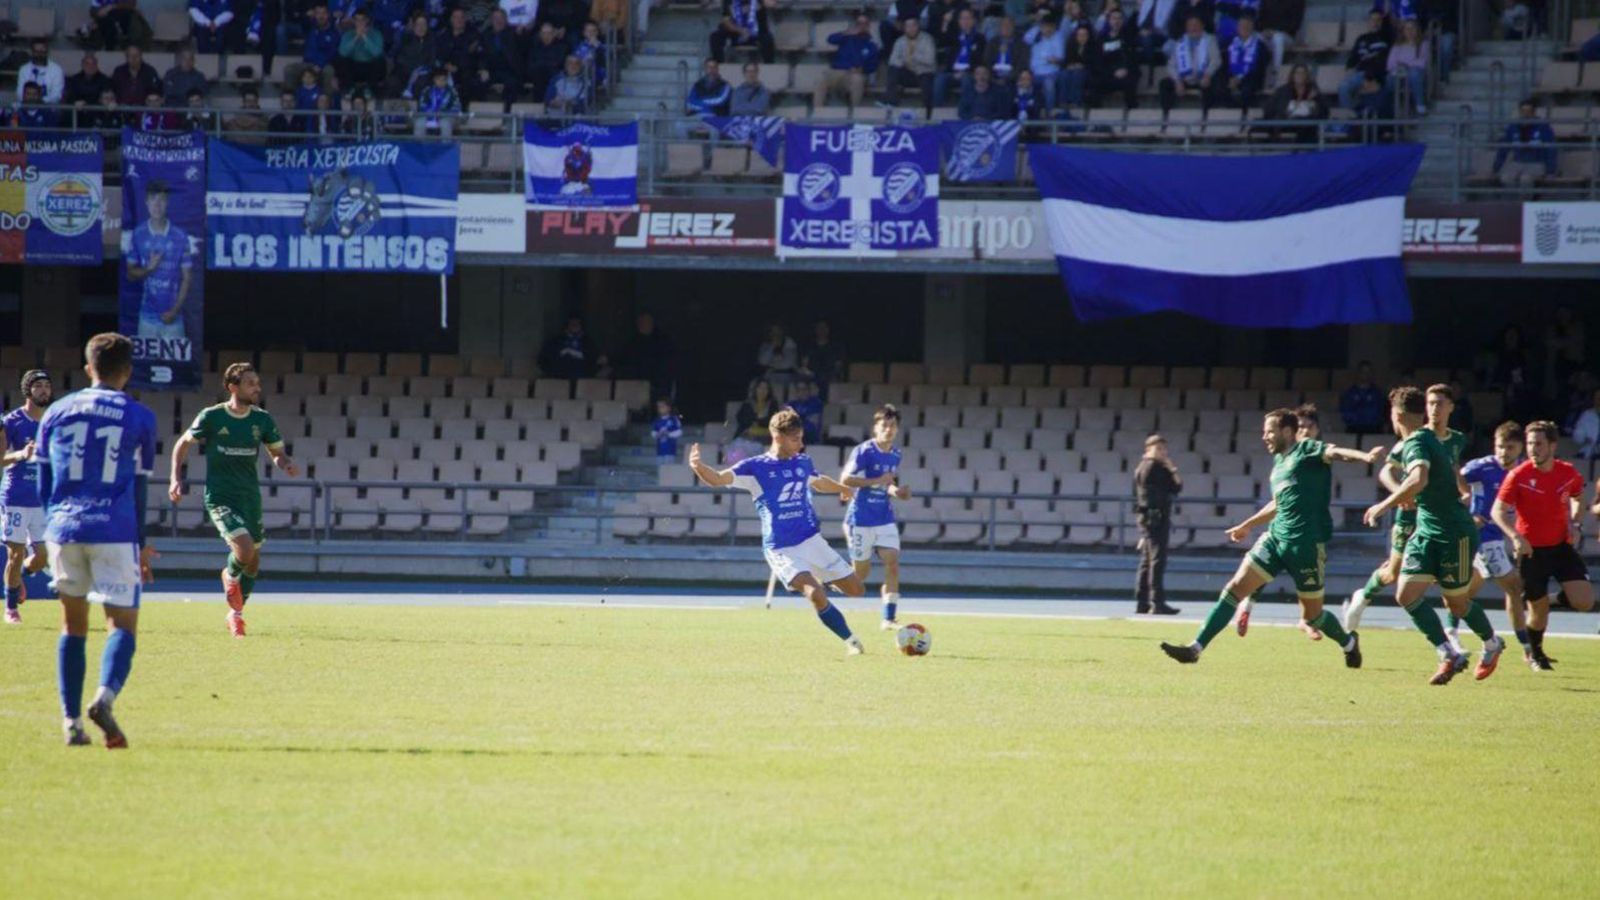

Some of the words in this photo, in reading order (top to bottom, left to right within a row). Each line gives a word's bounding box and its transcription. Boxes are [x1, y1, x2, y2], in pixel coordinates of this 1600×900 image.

[0, 140, 20, 153] UNA
[24, 140, 58, 153] MISMA
[60, 137, 98, 153] PASIÓN
[811, 130, 915, 152] FUERZA
[266, 147, 309, 168] PEÑA
[313, 144, 400, 168] XERECISTA
[0, 164, 38, 181] TAS
[47, 198, 91, 210] XEREZ
[0, 212, 31, 230] DO
[542, 211, 632, 235] PLAY
[789, 219, 933, 244] XERECISTA
[214, 233, 278, 268] LOS
[288, 233, 450, 271] INTENSOS
[131, 336, 193, 361] BENY
[150, 365, 172, 383] 3
[62, 420, 124, 483] 11
